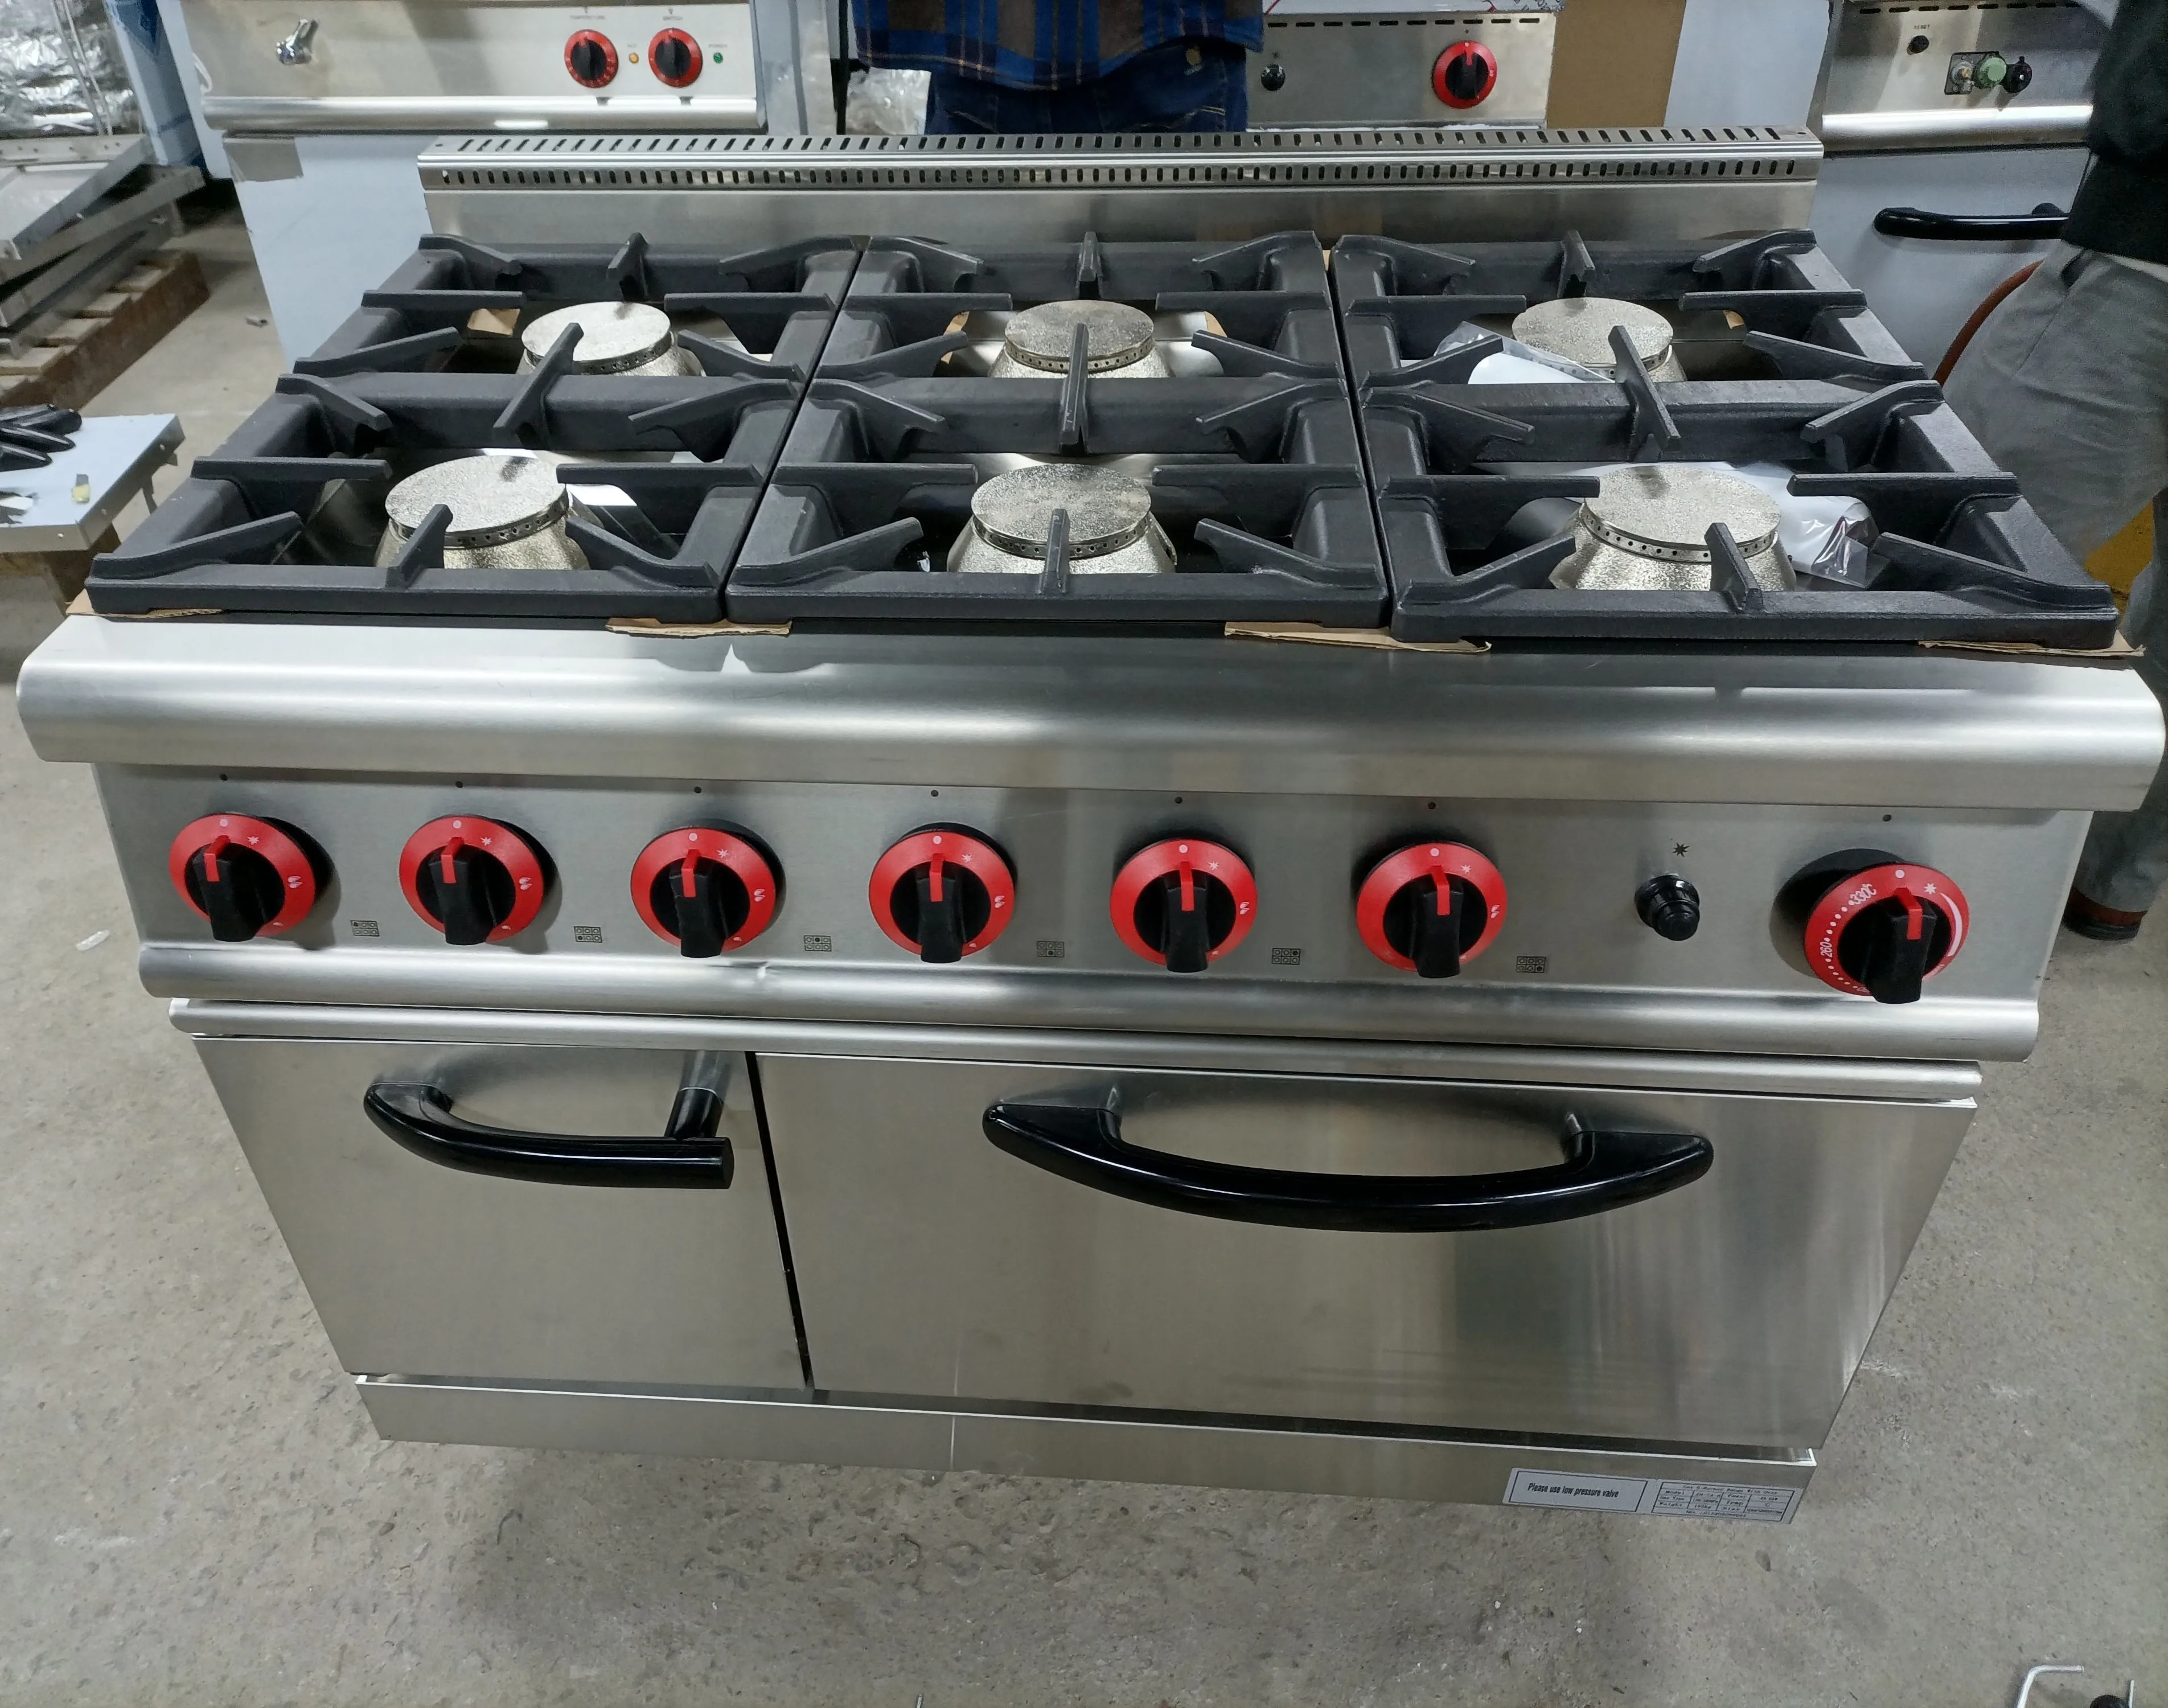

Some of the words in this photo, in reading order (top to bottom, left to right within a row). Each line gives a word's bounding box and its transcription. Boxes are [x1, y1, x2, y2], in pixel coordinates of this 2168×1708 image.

[1820, 941, 1833, 958] 260
[1528, 1483, 1548, 1492] Please
[1562, 1485, 1574, 1494] low
[1574, 1488, 1600, 1496] pressure
[1602, 1489, 1619, 1498] valve
